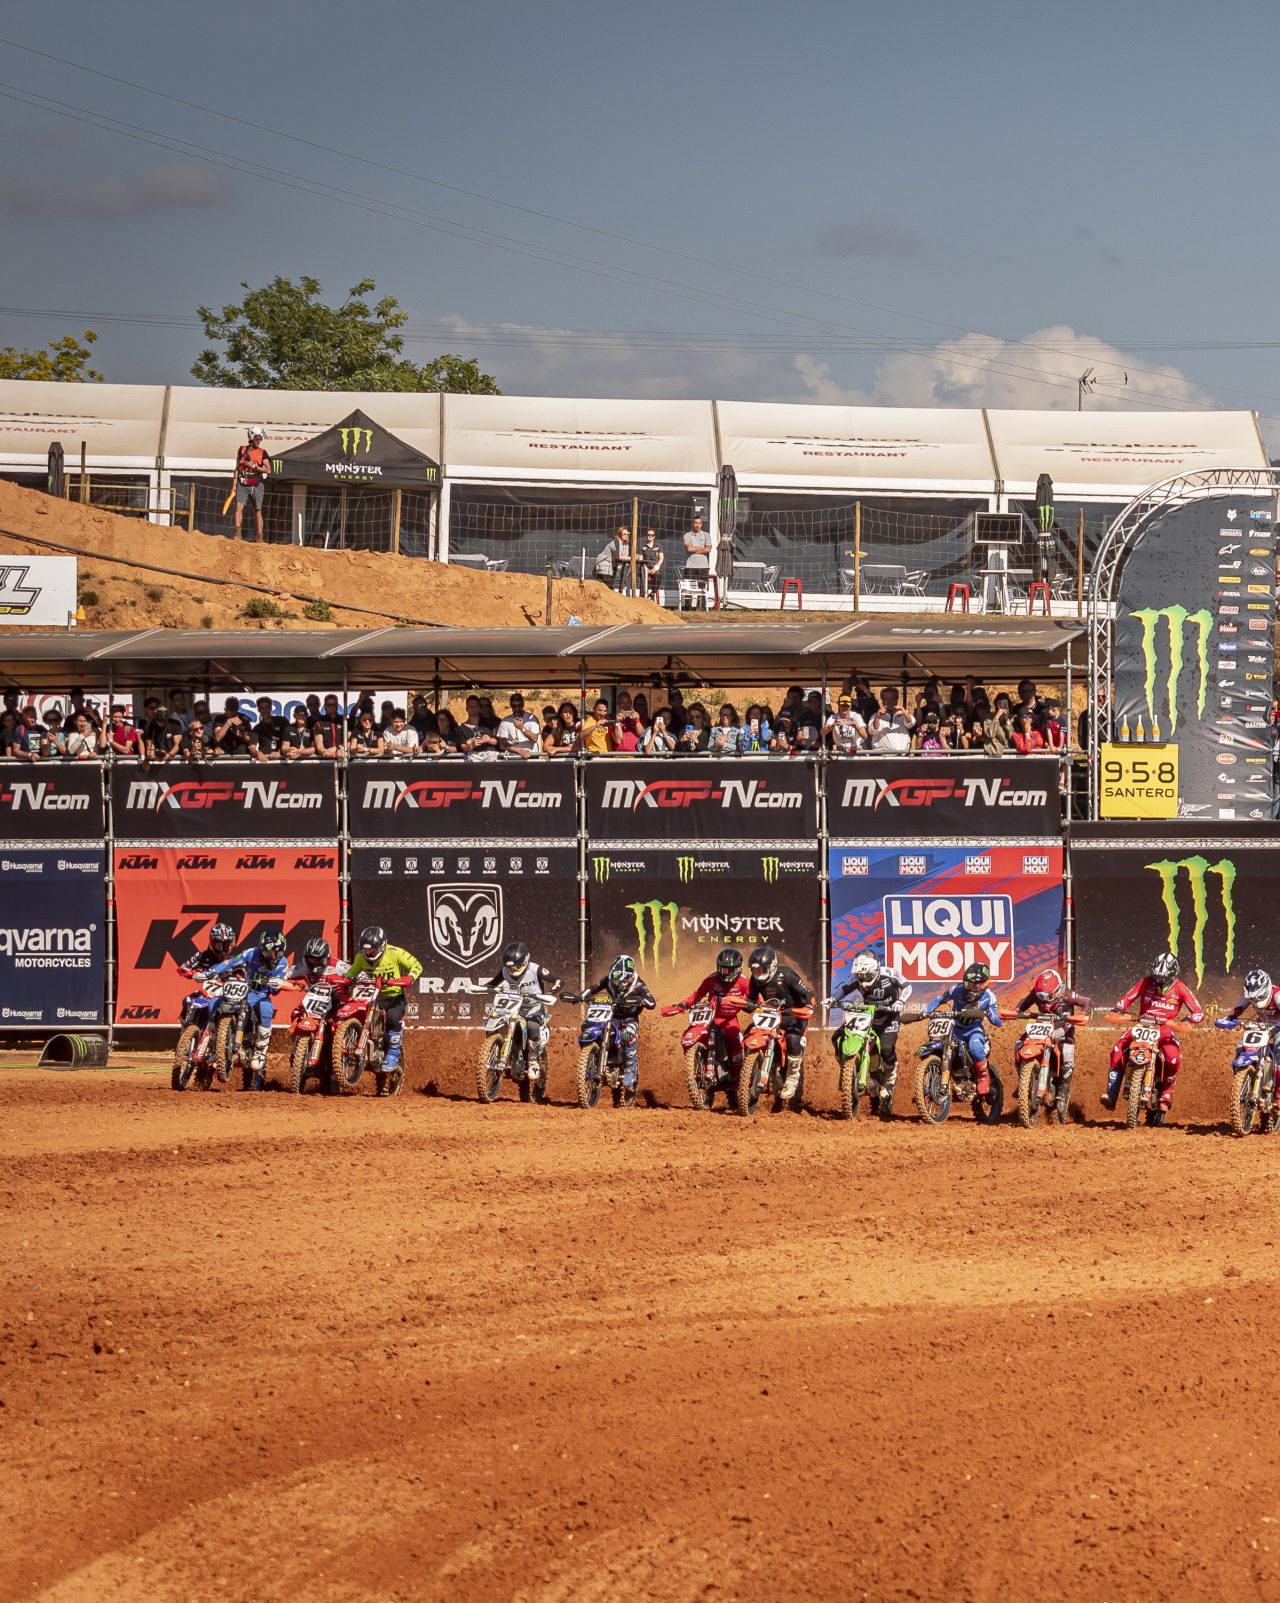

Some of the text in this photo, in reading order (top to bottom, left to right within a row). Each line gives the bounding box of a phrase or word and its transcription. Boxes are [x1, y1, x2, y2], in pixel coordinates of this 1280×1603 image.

[529, 443, 632, 451] RESTAURANT
[326, 462, 382, 475] MONSTER
[1105, 788, 1174, 797] SANTERO
[119, 855, 158, 870] KTM
[177, 855, 217, 870] KTM
[235, 855, 275, 870] KTM
[294, 855, 334, 870] KTM
[842, 857, 868, 865] LIQUI
[900, 857, 926, 865] LIQUI
[965, 856, 991, 865] LIQUI
[1023, 856, 1049, 864] LIQUI
[842, 866, 868, 874] MOLY
[900, 866, 926, 874] MOLY
[965, 865, 991, 873] MOLY
[1023, 865, 1049, 873] MOLY
[682, 914, 784, 933] MONSTER
[892, 899, 1005, 938] LIQUI
[0, 929, 91, 956] qvarna
[134, 905, 325, 970] KTM
[16, 958, 91, 968] MOTORCYCLES
[892, 941, 1010, 977] MOLY
[205, 983, 221, 992] 77
[225, 983, 247, 996] 959
[354, 987, 374, 999] 75
[120, 1005, 160, 1019] KTM
[590, 1008, 612, 1020] 271
[691, 1011, 712, 1022] 161
[757, 1015, 776, 1028] 71
[929, 1020, 949, 1035] 259
[1029, 1025, 1051, 1036] 226
[1135, 1029, 1158, 1041] 303
[1245, 1032, 1263, 1044] 6
